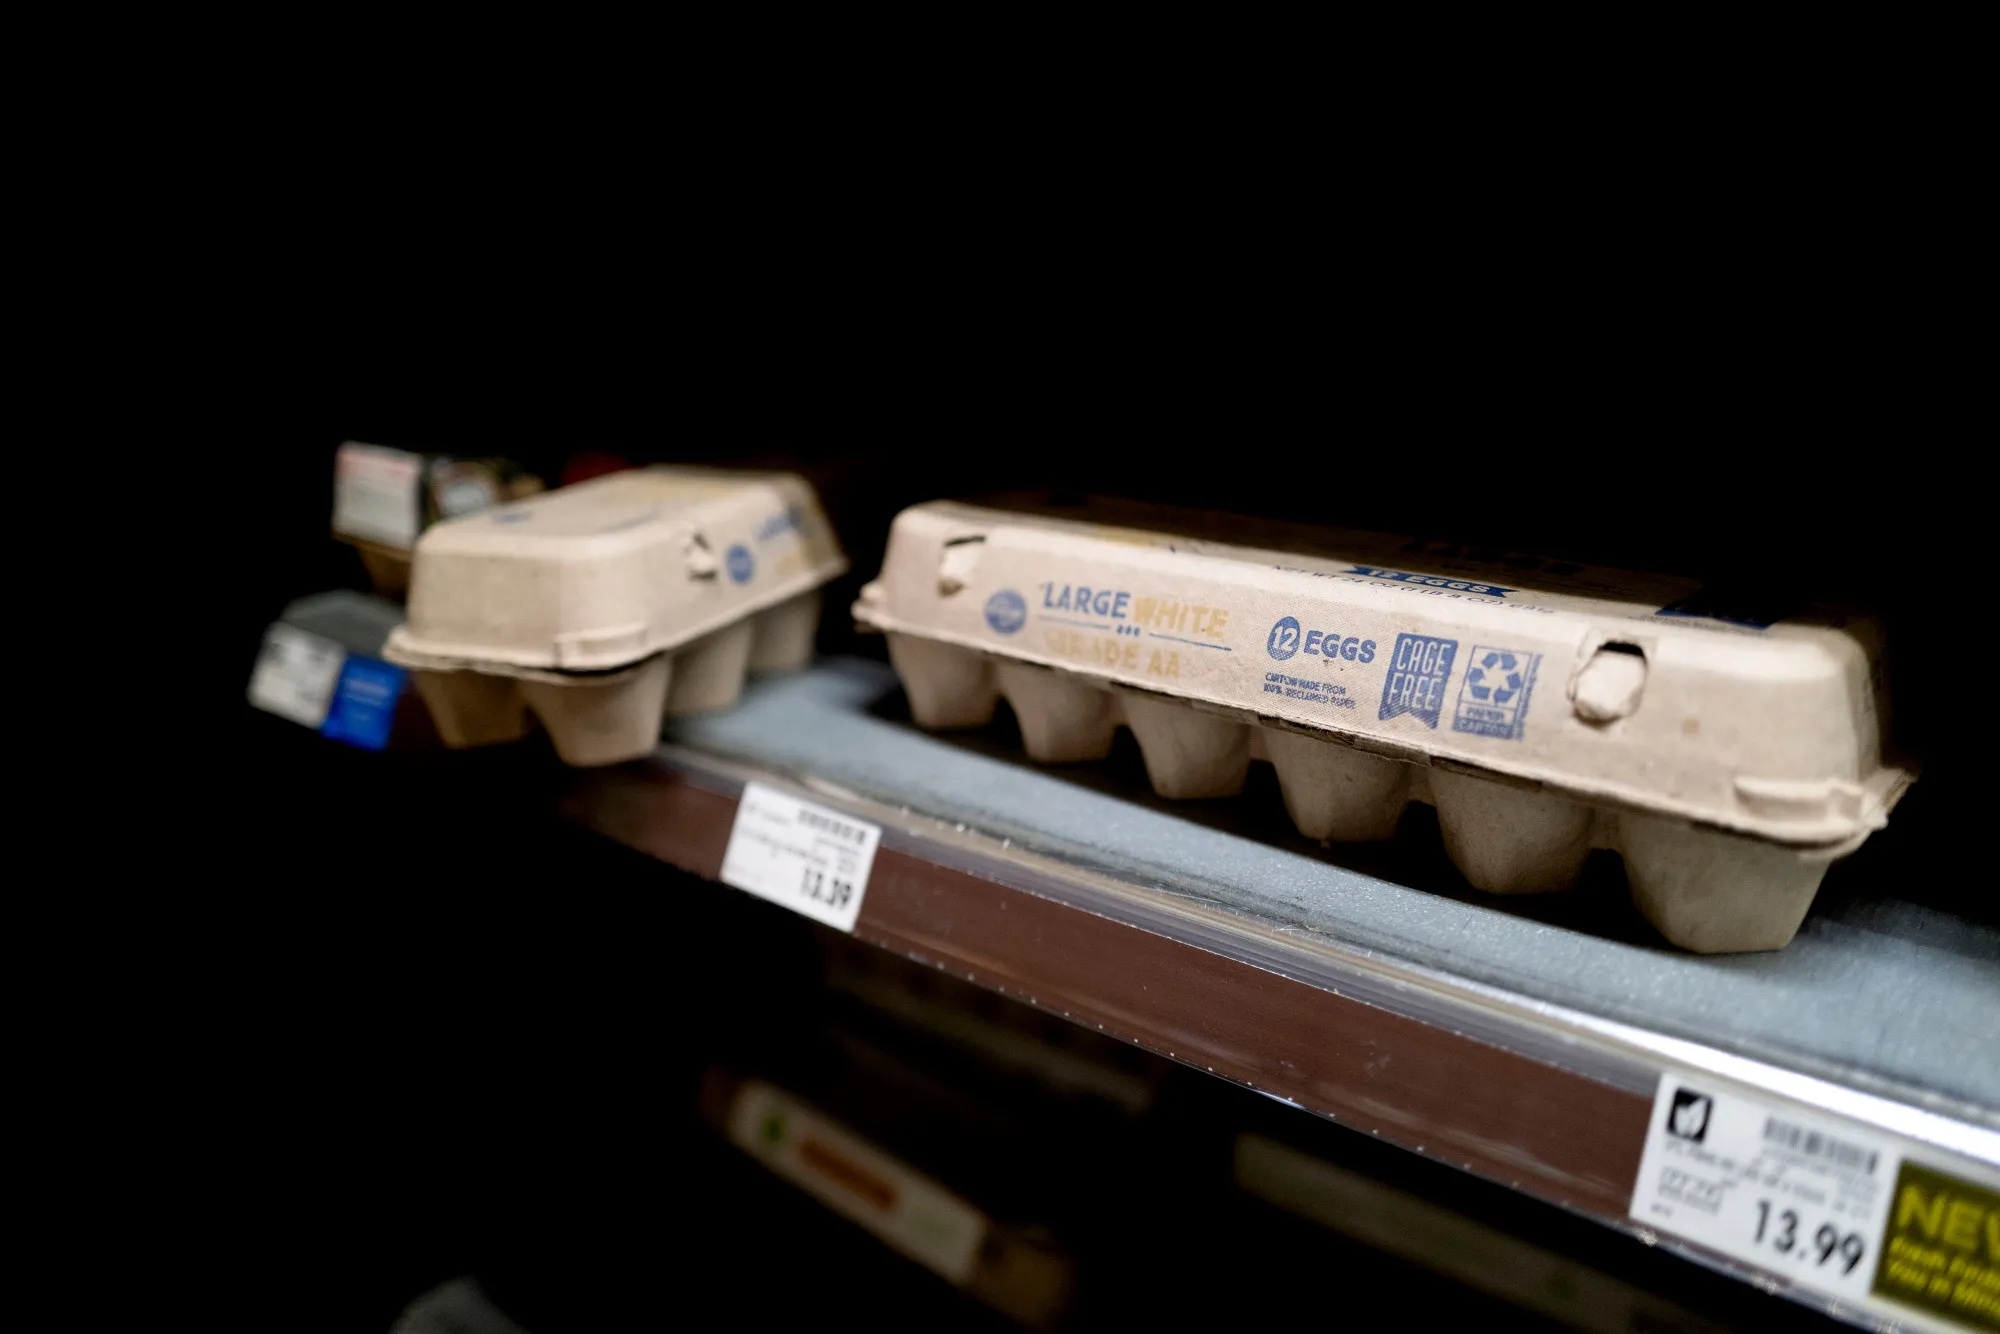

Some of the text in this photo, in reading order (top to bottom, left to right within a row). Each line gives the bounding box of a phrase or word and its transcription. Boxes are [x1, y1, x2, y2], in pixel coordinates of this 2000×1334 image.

[1405, 575, 1491, 593] EGGS
[1042, 581, 1131, 619] LARGE
[1133, 597, 1229, 638] WHITE
[1146, 650, 1180, 678] AA
[1272, 625, 1376, 664] 12 EGGS
[1395, 637, 1451, 676] CAGE
[1322, 683, 1346, 695] FROM
[1388, 672, 1441, 712] FREE
[1753, 1200, 1865, 1277] 13.99
